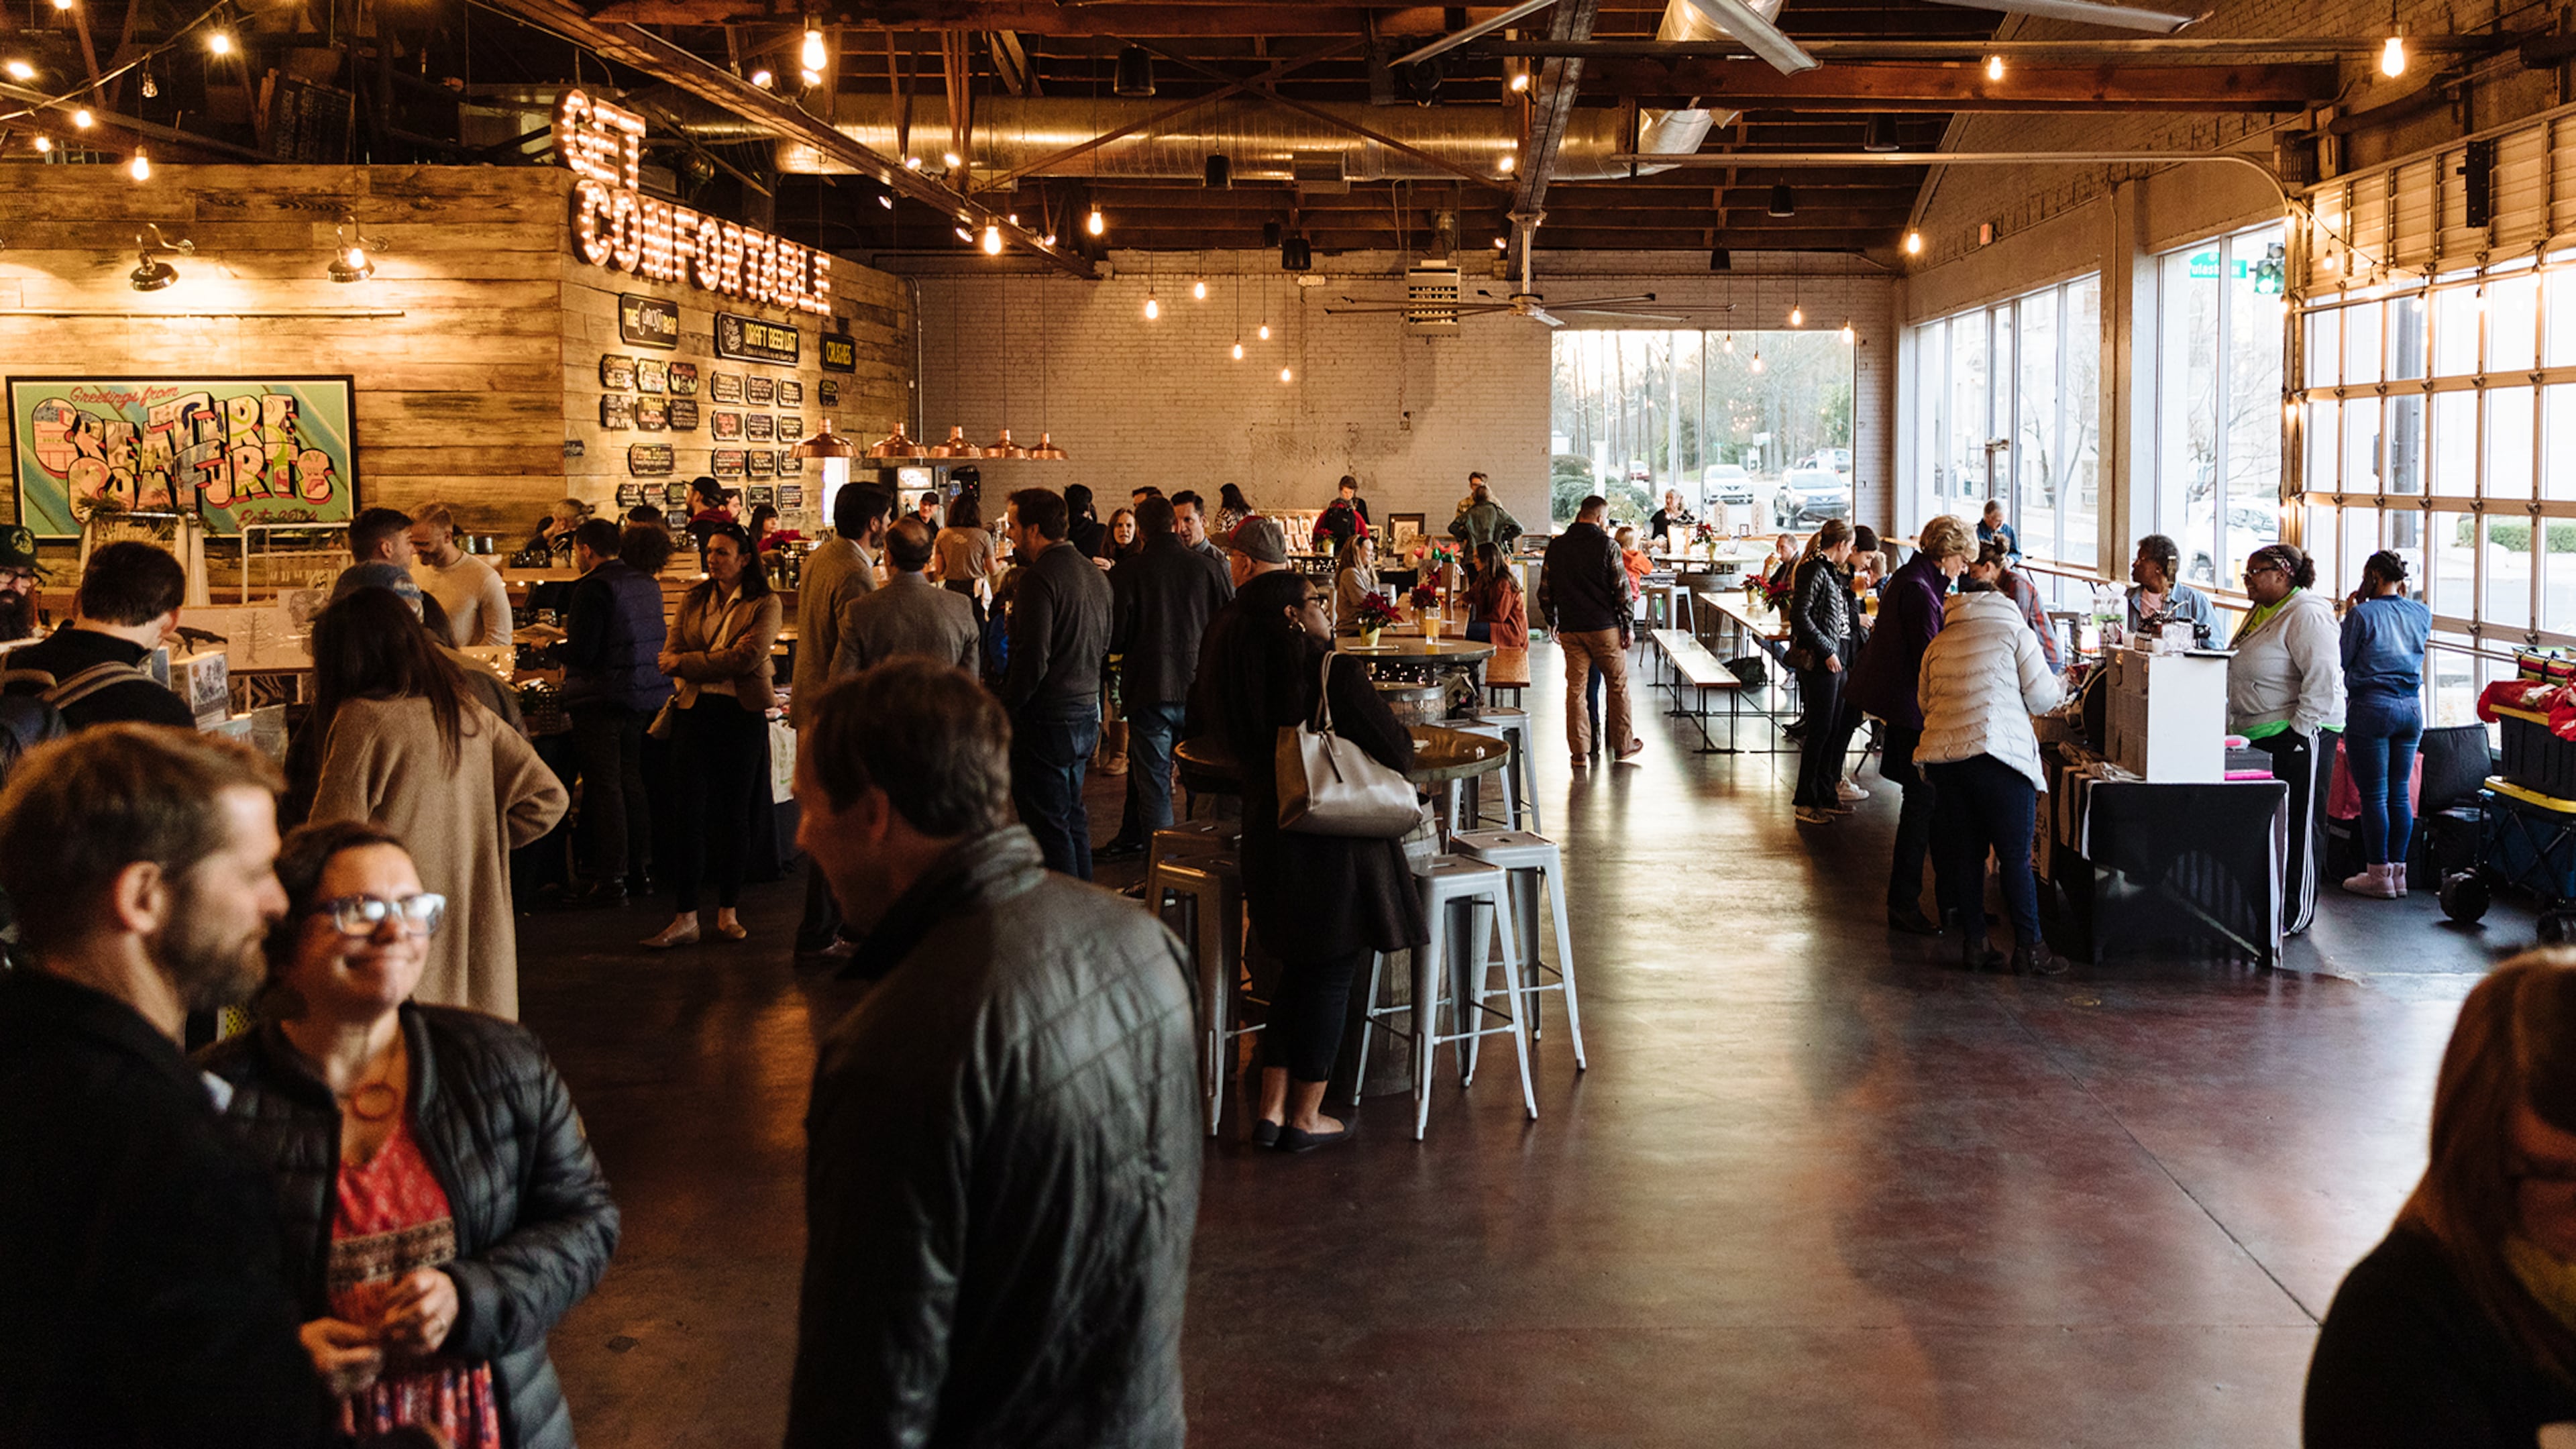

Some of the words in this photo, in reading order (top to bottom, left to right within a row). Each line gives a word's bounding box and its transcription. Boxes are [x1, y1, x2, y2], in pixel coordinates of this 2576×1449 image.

[552, 89, 646, 193] GET
[571, 179, 830, 317] COMFORTABLE
[745, 322, 767, 347] DRAFT
[767, 327, 784, 350] BEER
[69, 386, 139, 411] Greetings
[140, 385, 180, 407] from
